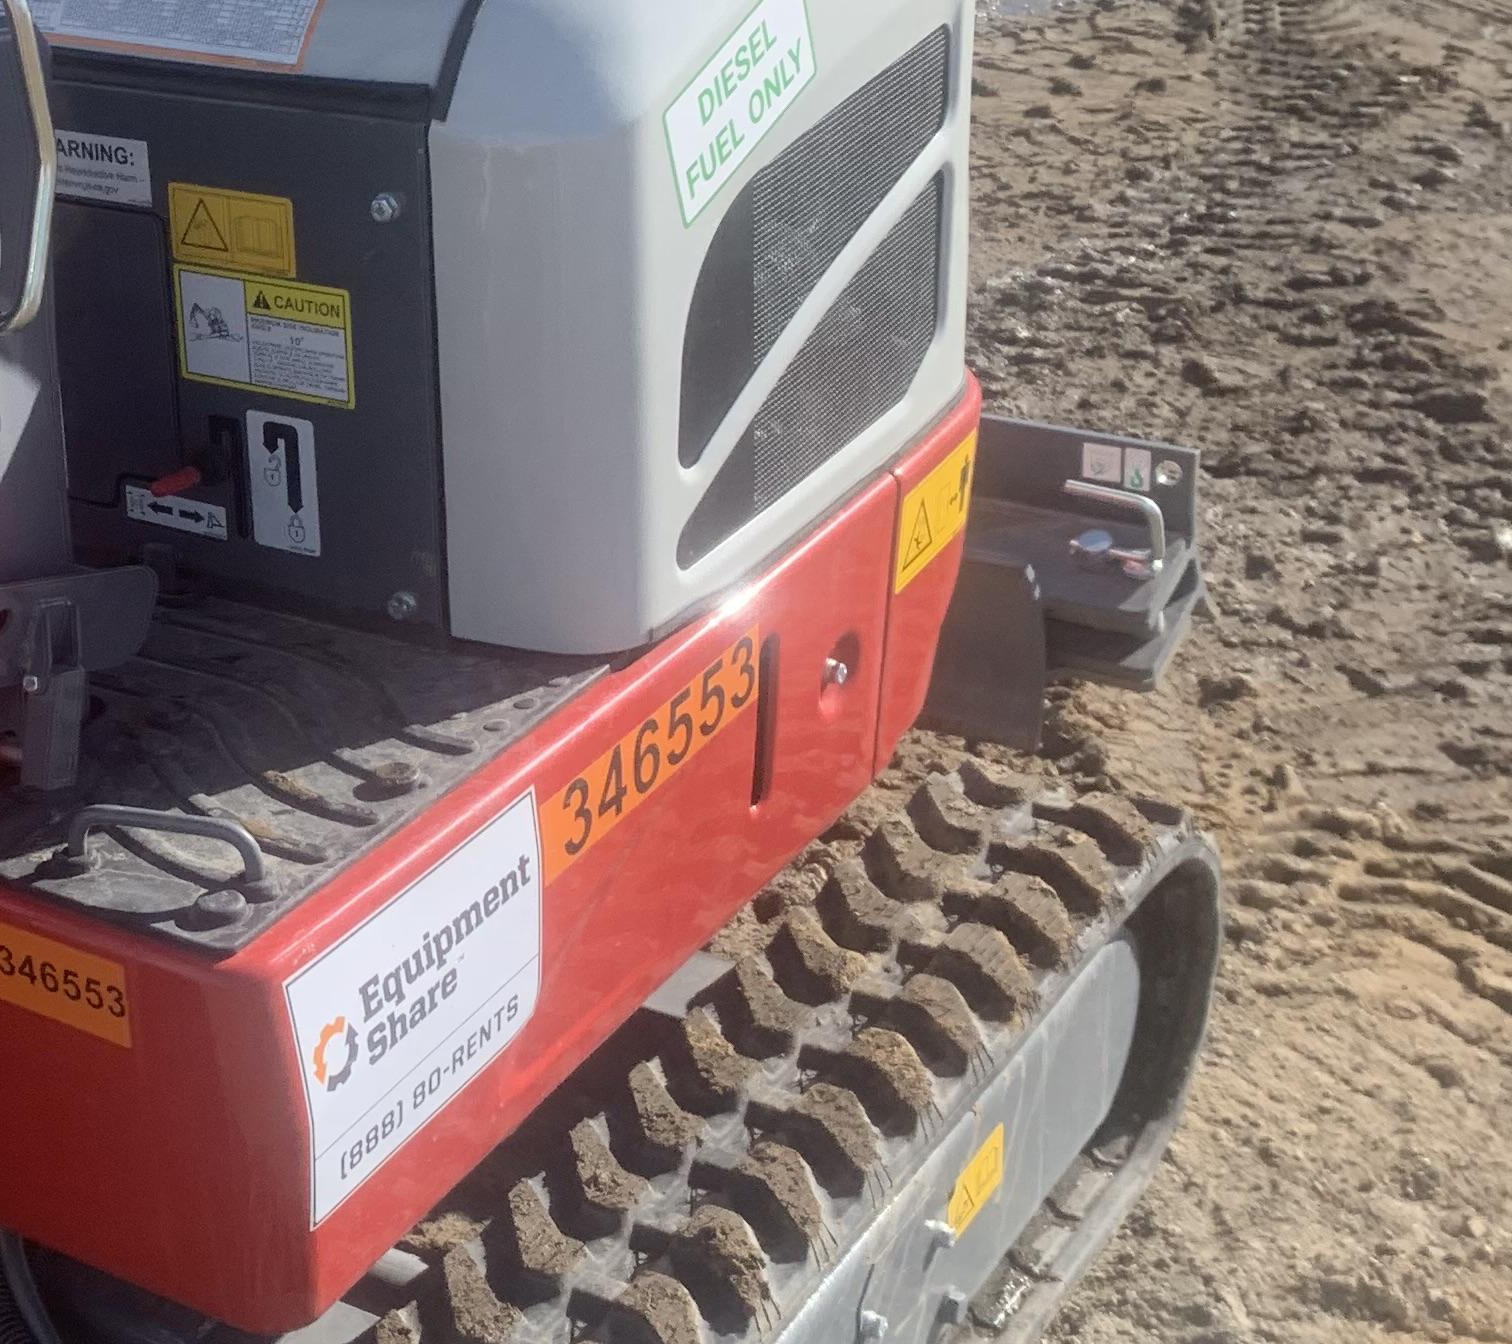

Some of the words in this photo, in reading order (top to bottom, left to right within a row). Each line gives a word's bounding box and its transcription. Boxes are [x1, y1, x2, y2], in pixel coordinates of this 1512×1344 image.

[686, 119, 745, 199] FUEL
[748, 37, 801, 124] ONLY
[697, 19, 777, 126] DIESEL
[56, 138, 134, 166] ARNING:
[274, 296, 340, 318] CAUTION
[563, 636, 755, 856] 346553
[359, 854, 531, 1022] Equipment
[367, 967, 458, 1065] Share
[341, 1101, 404, 1179] (888)
[413, 994, 519, 1110] 80-RENTS
